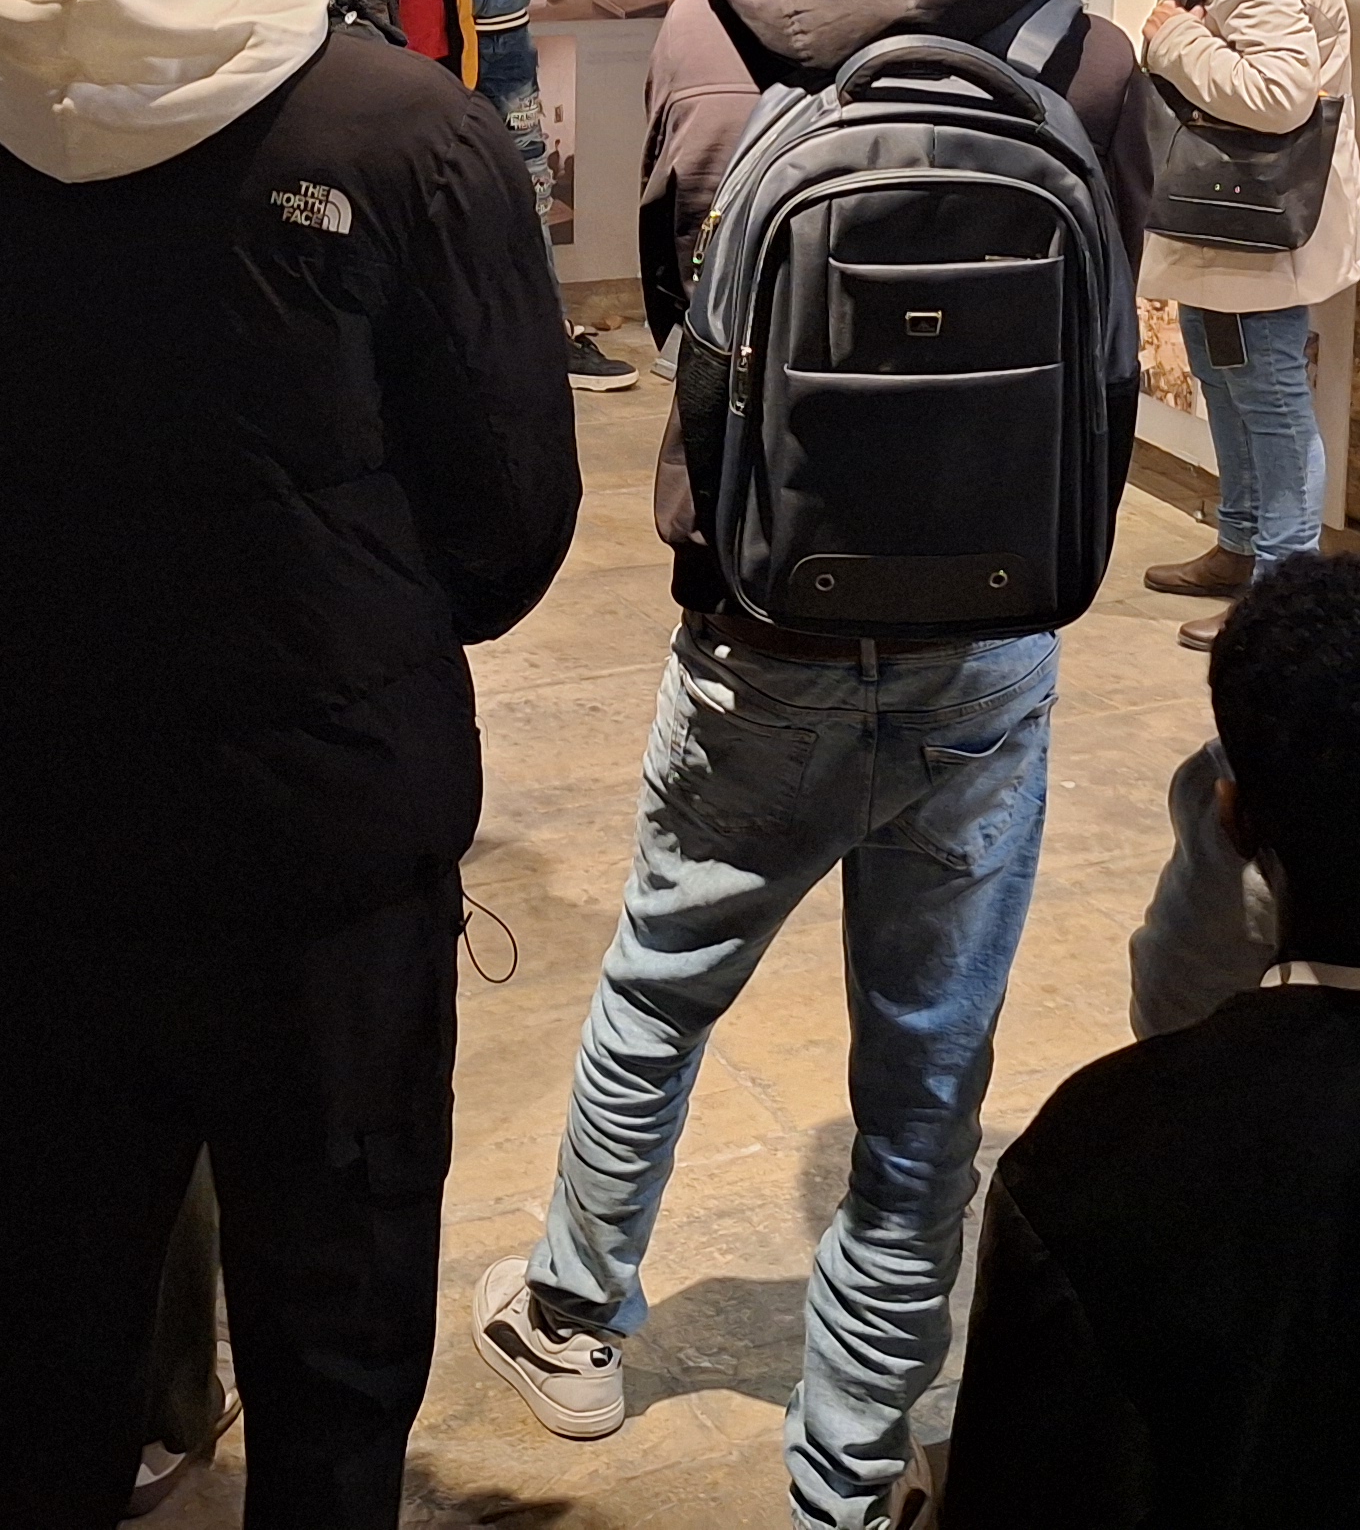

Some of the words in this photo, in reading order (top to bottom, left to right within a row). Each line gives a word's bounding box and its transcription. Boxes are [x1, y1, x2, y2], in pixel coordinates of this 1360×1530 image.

[300, 180, 330, 200] THE
[270, 190, 326, 214] NORTH
[282, 206, 324, 228] FACE
